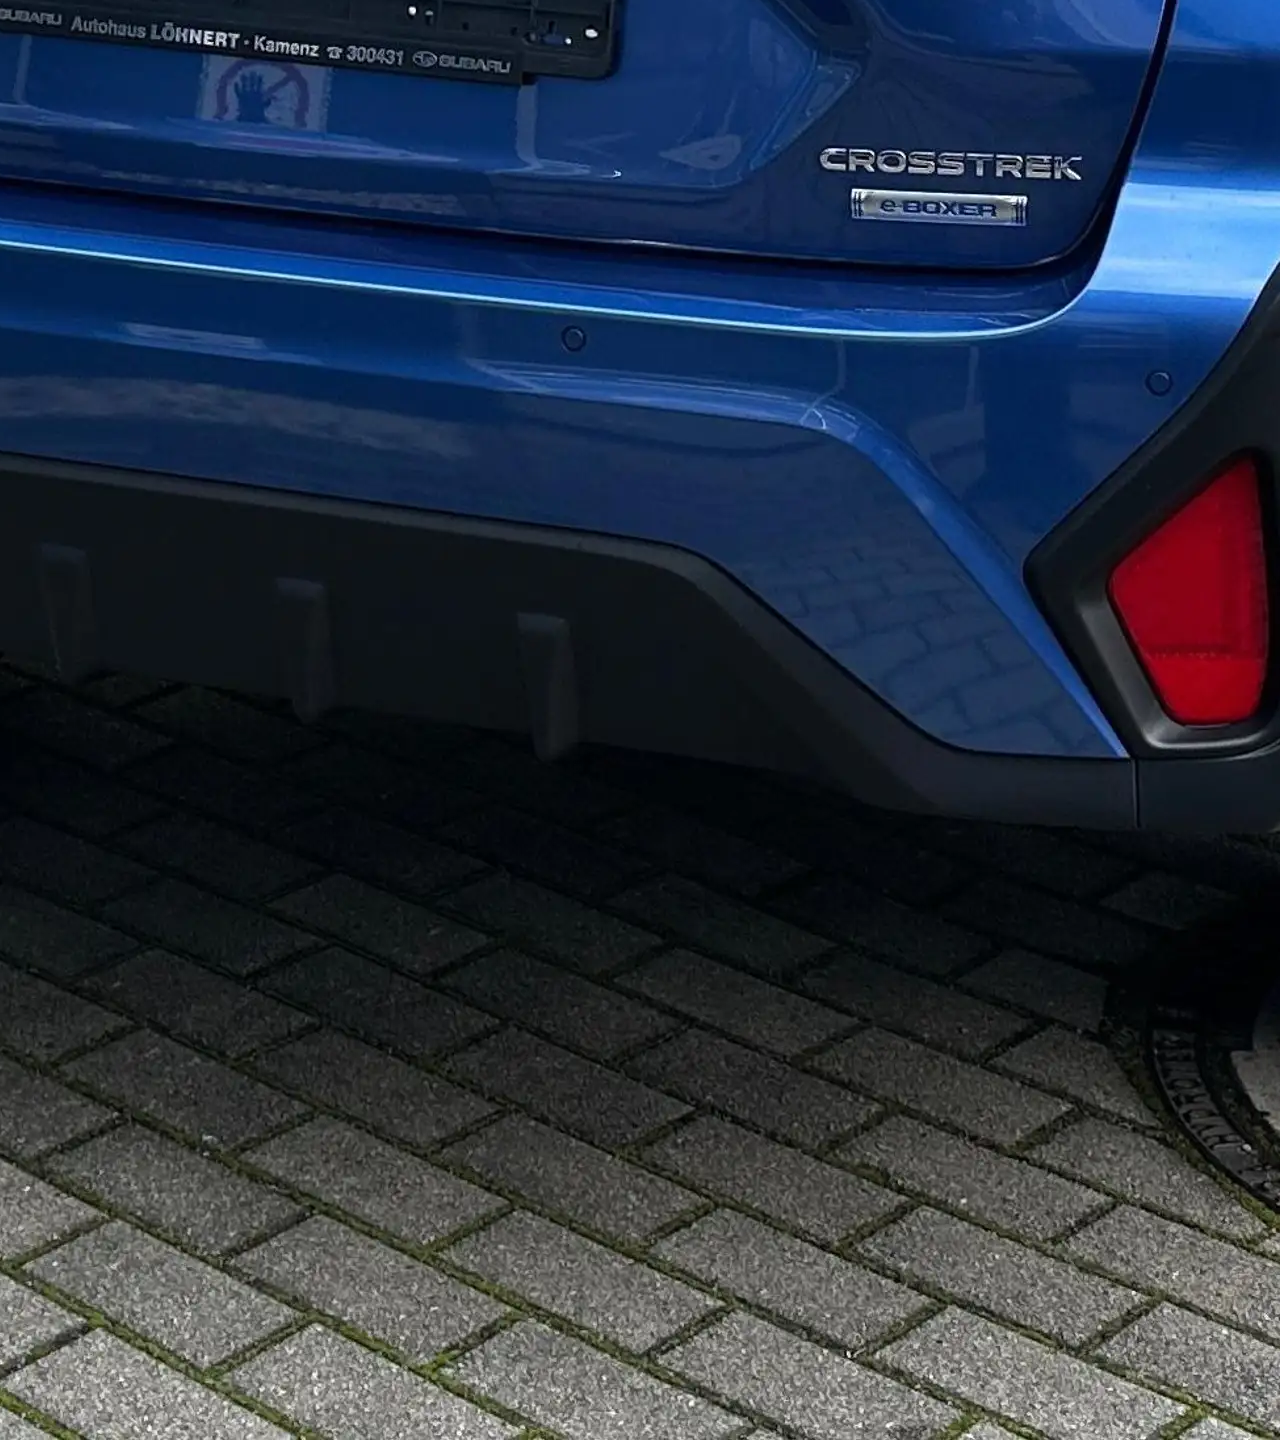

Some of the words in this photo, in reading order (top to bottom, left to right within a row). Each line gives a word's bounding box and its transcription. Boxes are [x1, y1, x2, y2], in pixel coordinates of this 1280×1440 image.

[70, 15, 147, 39] Autohaus
[151, 22, 241, 49] LÖHNERT
[254, 35, 320, 57] Kamenz
[347, 45, 404, 66] 300431
[439, 53, 511, 74] SUBARU
[820, 147, 1083, 181] CROSSTREK
